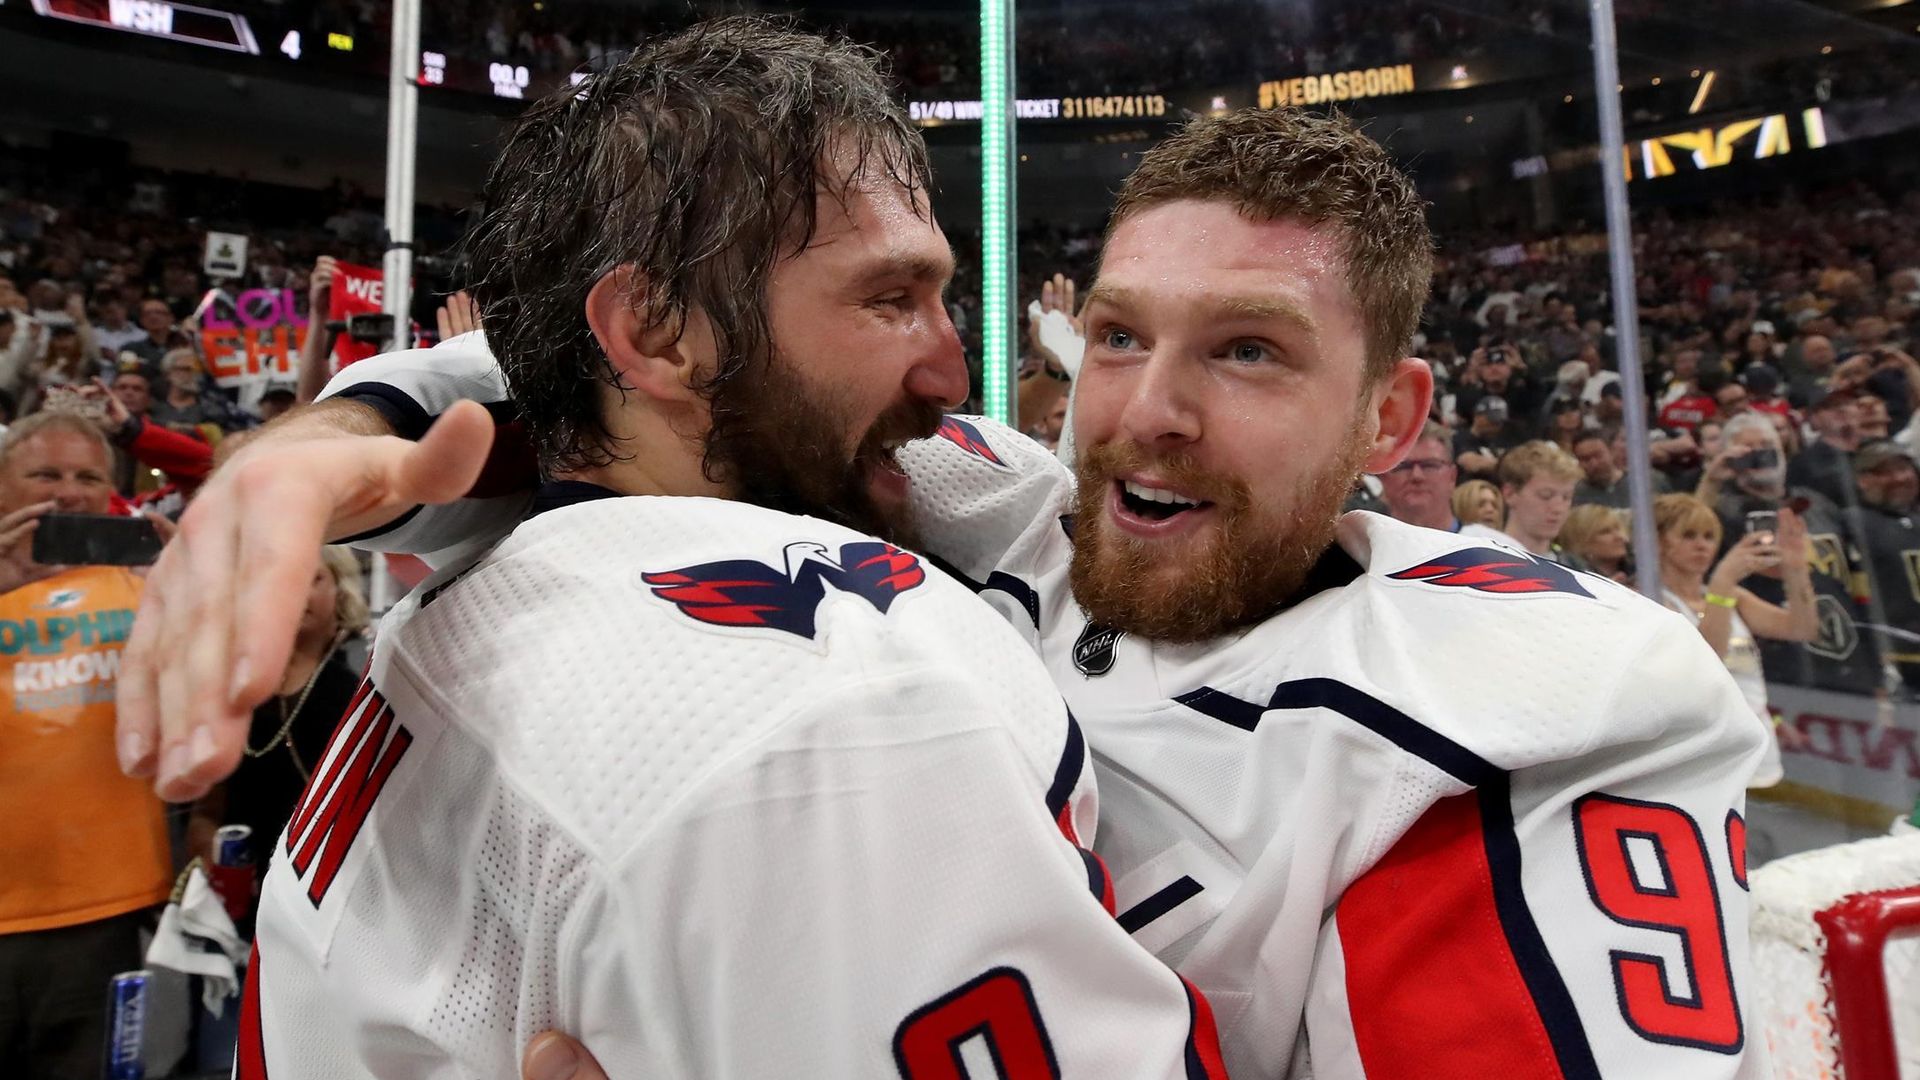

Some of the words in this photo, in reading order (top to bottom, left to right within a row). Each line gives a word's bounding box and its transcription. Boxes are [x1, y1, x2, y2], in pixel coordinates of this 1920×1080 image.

[109, 0, 173, 34] WSH
[281, 30, 300, 59] 4
[202, 327, 310, 377] EH
[1079, 633, 1113, 660] NHL
[1571, 791, 1750, 1055] 9
